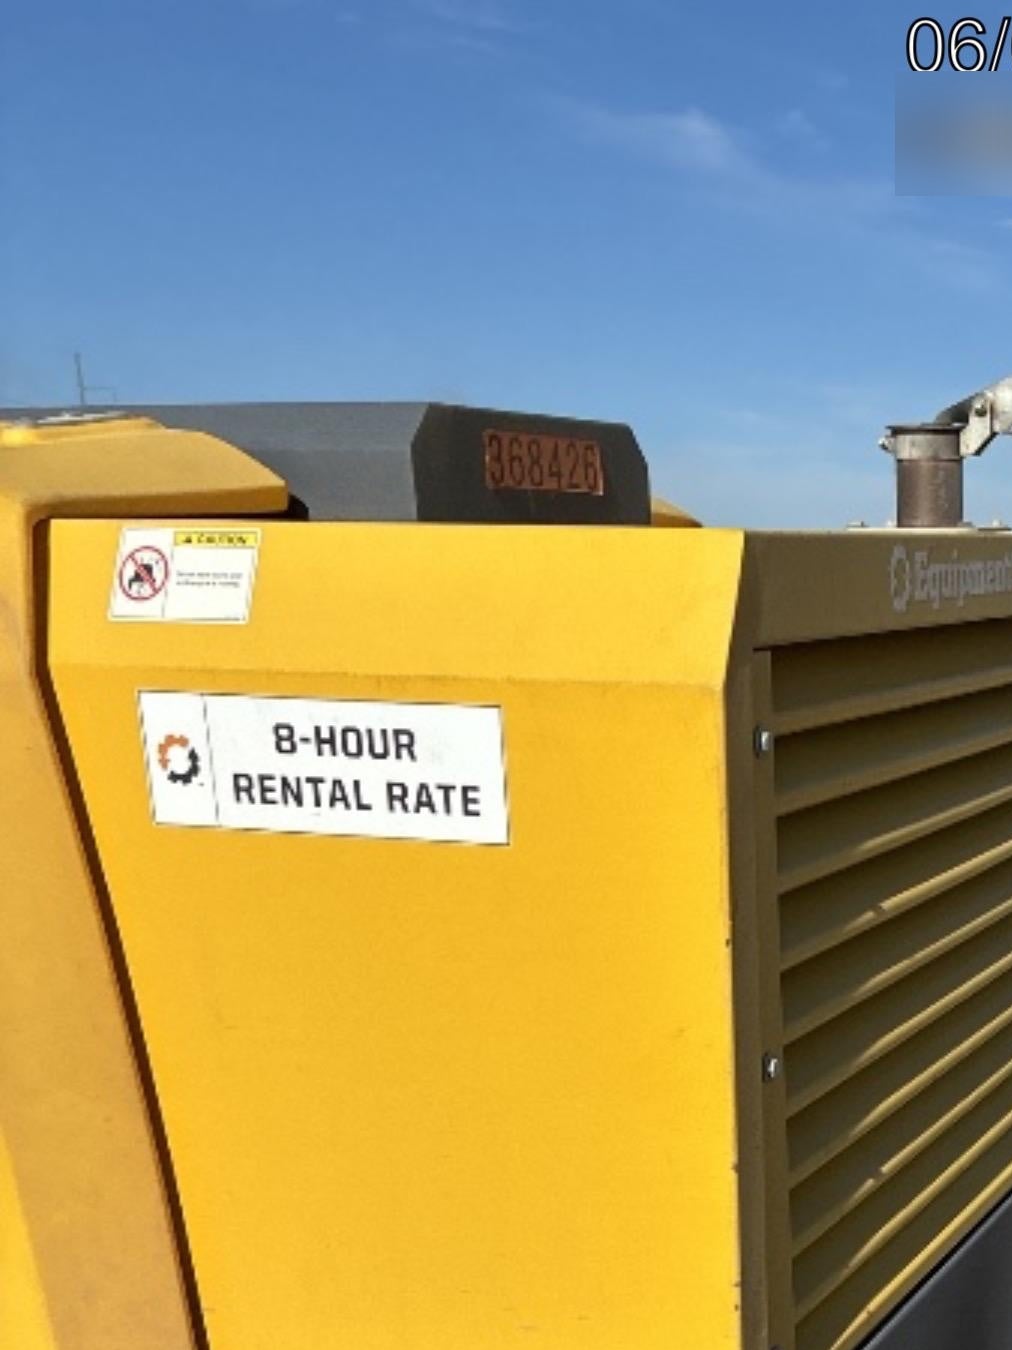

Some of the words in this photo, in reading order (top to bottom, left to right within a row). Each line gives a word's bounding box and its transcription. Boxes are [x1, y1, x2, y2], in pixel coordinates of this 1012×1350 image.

[488, 433, 598, 490] 368426
[272, 723, 418, 762] 8-HOUR
[233, 773, 372, 812] RENTAL
[386, 782, 482, 817] RATE
